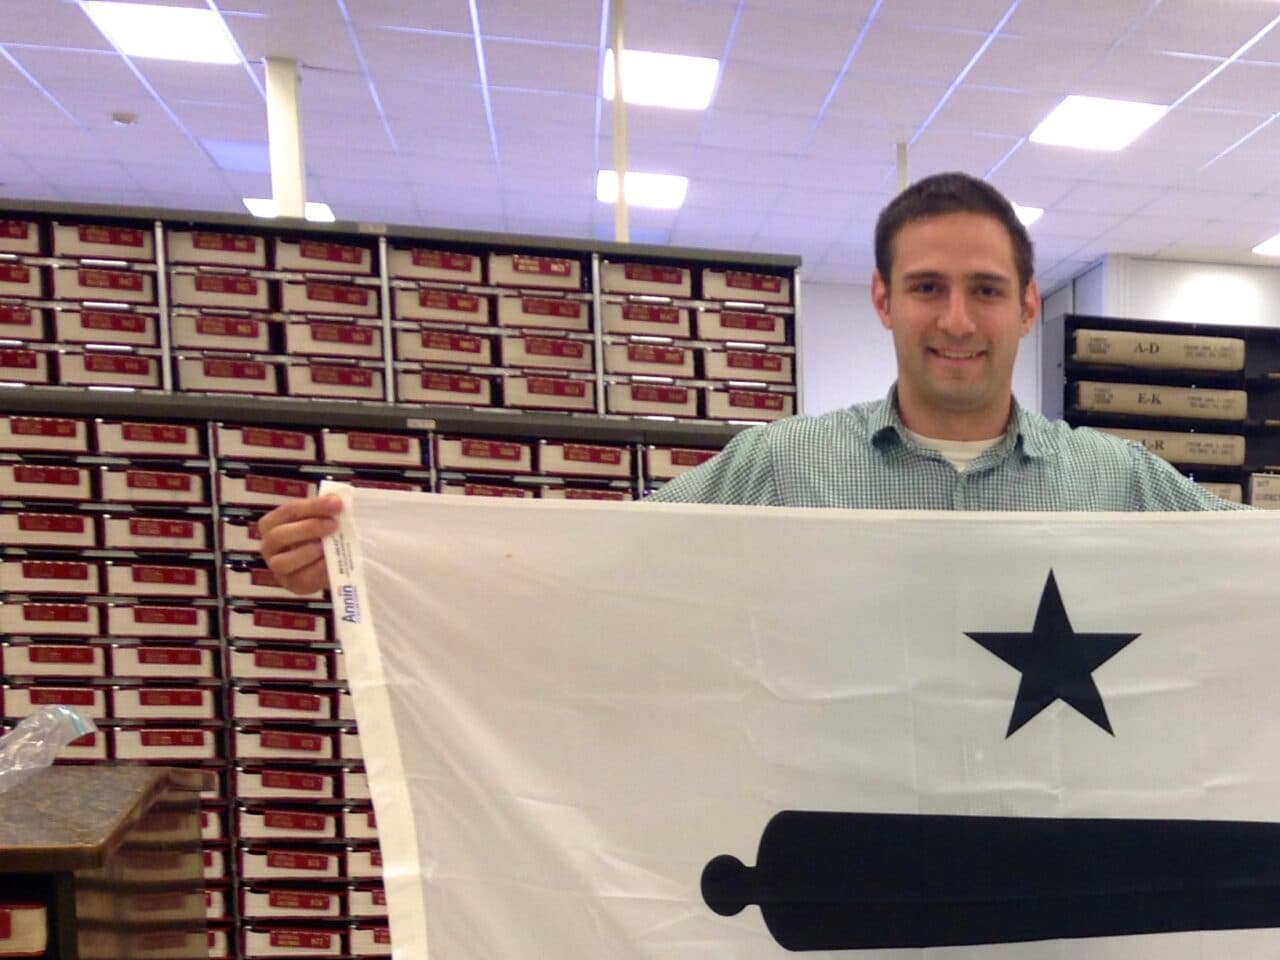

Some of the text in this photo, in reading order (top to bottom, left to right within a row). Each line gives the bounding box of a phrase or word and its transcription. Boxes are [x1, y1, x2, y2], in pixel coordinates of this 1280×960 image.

[1135, 343, 1160, 353] A-D
[1137, 392, 1161, 405] E-K
[341, 585, 356, 623] Annin
